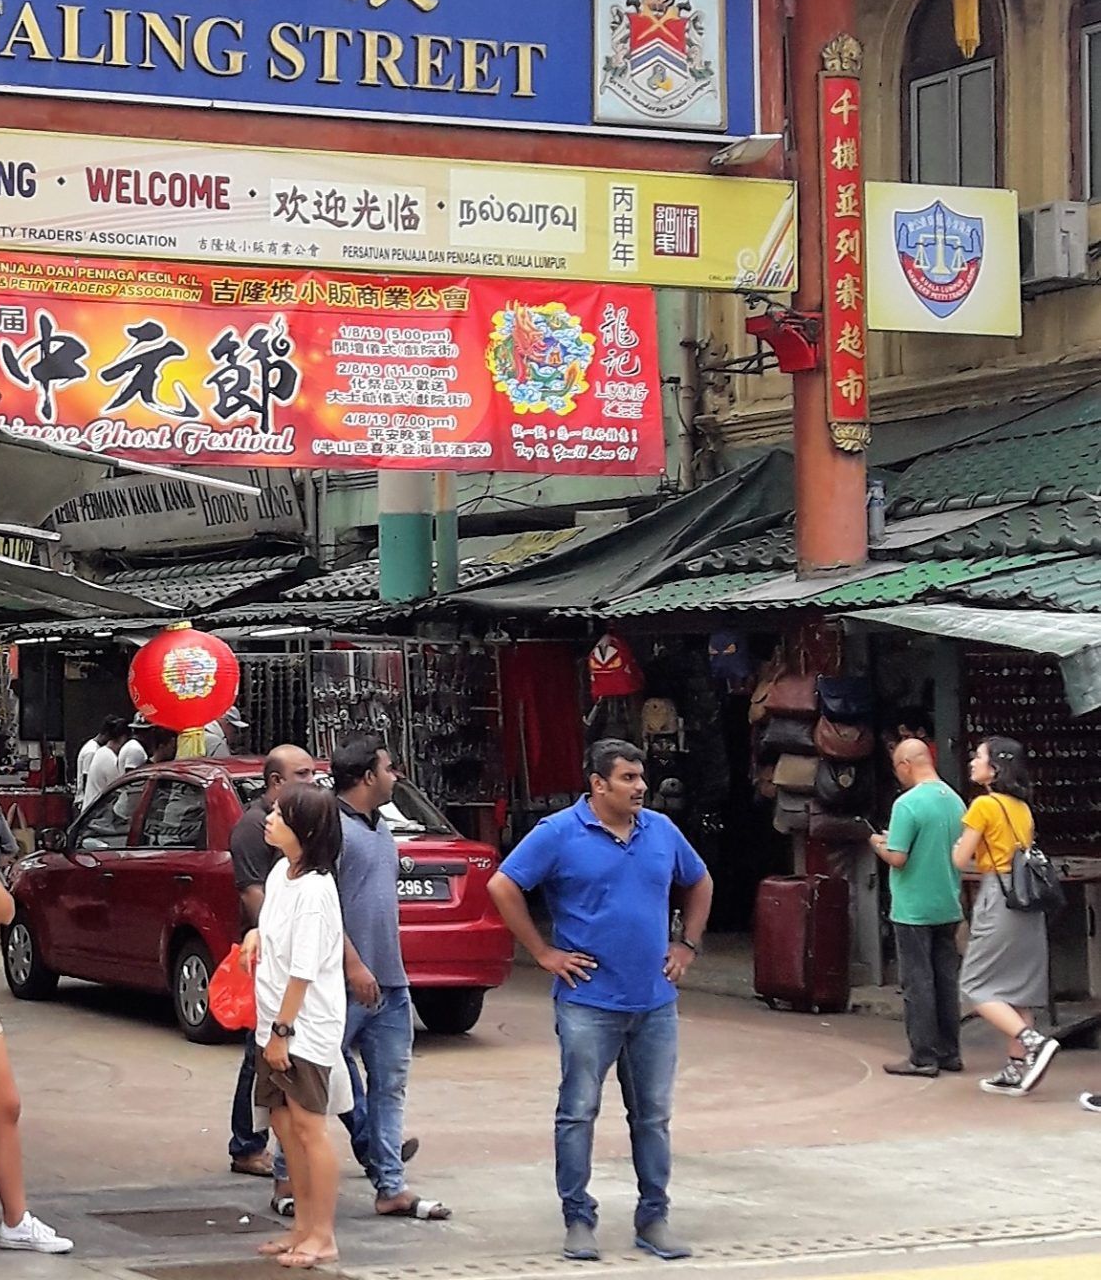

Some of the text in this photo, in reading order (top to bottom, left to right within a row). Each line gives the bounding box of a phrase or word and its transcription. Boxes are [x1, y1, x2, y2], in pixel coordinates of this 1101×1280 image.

[268, 21, 549, 98] STREET
[86, 167, 231, 210] WELCOME
[273, 184, 421, 232] 欢迎光临
[459, 194, 578, 232] நல்வரவு
[612, 186, 636, 268] 丙申年
[89, 232, 177, 248] ASSOCIATION
[342, 246, 567, 269] PERSATUAN PENJAJA DAN PENIAGA KECIL KUALA LUMPUR
[47, 265, 75, 278] DAN
[77, 267, 135, 282] PENIAGA
[137, 271, 174, 284] KECIL
[178, 274, 203, 286] K.L.
[10, 278, 49, 291] PETTY
[118, 286, 203, 302] ASSOCIATION
[212, 279, 470, 312] 吉隆坡小販商業公會
[340, 326, 452, 342] 1/8/19 (5.00pm)
[600, 303, 641, 377] 龍記
[337, 363, 457, 379] 2/8/19 (11.00pm)
[344, 414, 456, 429] 4/8/19 (7.00pm)
[83, 419, 171, 453] Ghost
[175, 424, 295, 455] Festival
[513, 441, 534, 460] Try
[588, 444, 616, 460] Love
[396, 879, 434, 896] 296 S
